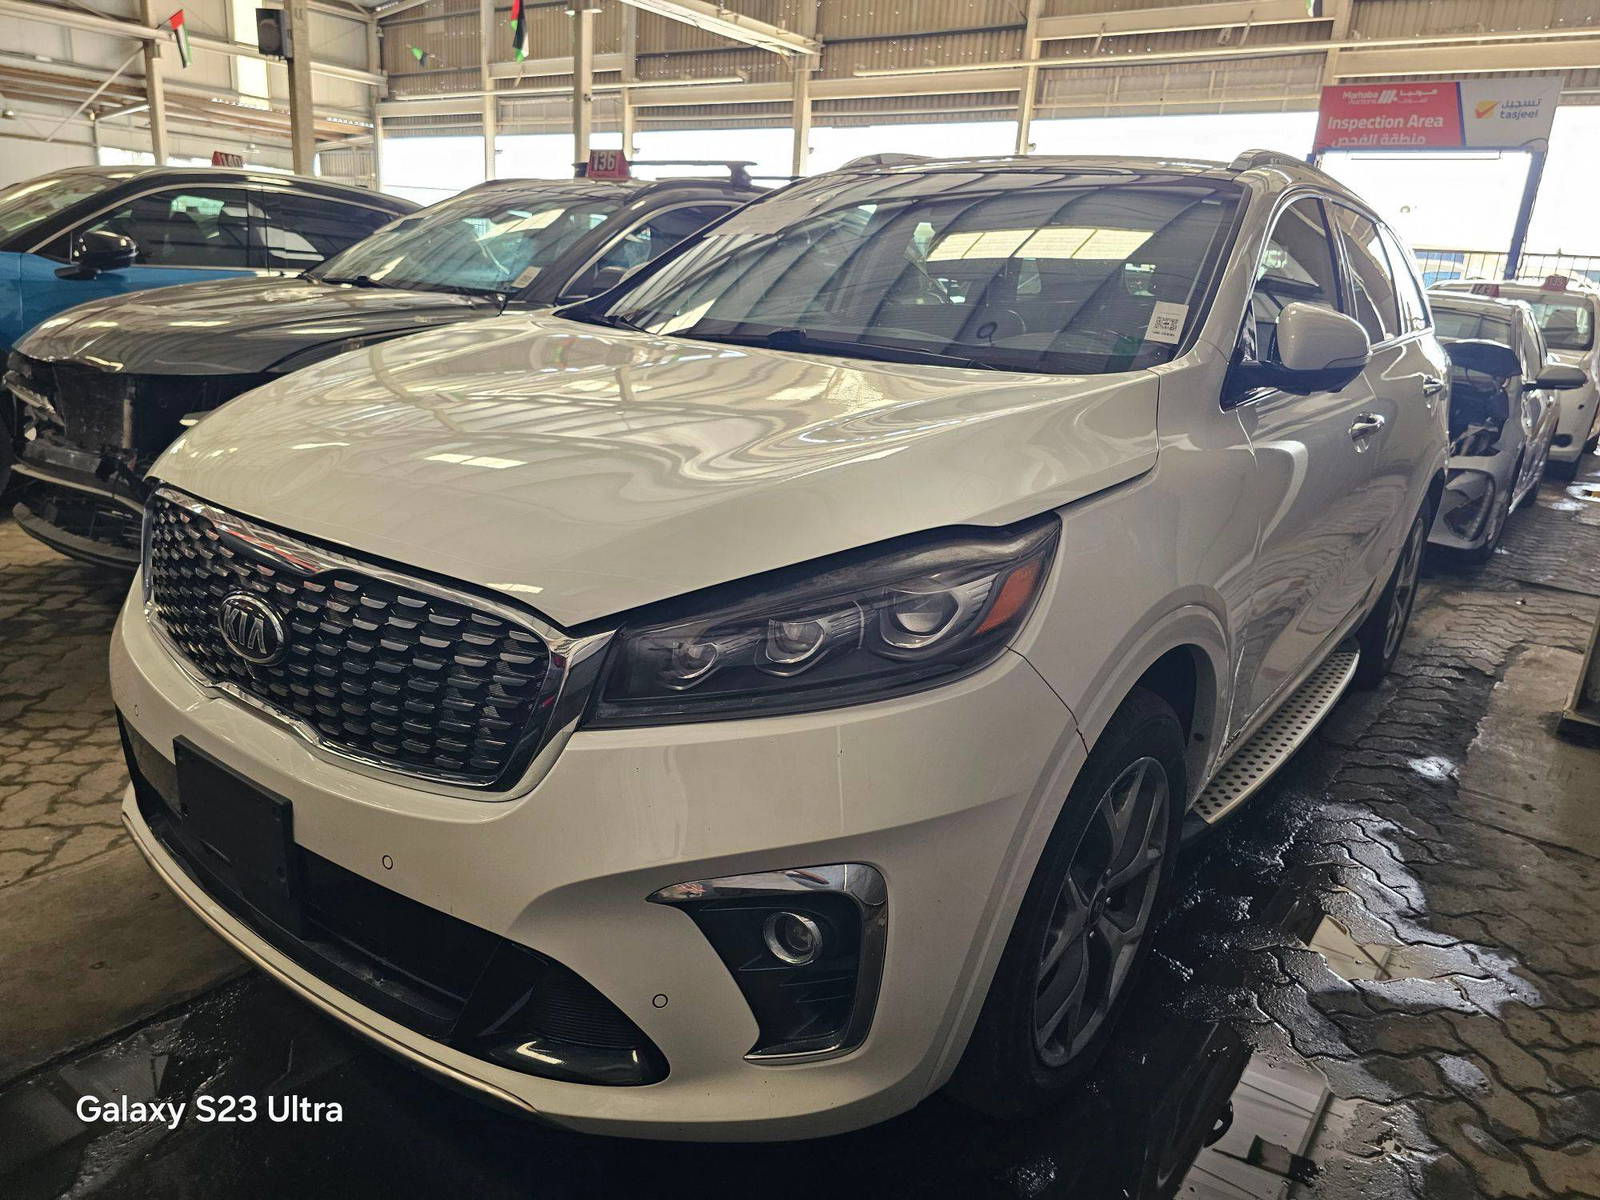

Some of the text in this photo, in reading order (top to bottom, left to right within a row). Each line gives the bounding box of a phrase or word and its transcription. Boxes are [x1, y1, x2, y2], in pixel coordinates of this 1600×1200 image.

[1501, 97, 1542, 109] تسجيل
[1500, 109, 1538, 120] tasjeel
[1328, 114, 1444, 132] Inspection Area
[1380, 133, 1426, 145] منطقة
[592, 152, 616, 170] 136
[224, 604, 267, 654] KIA
